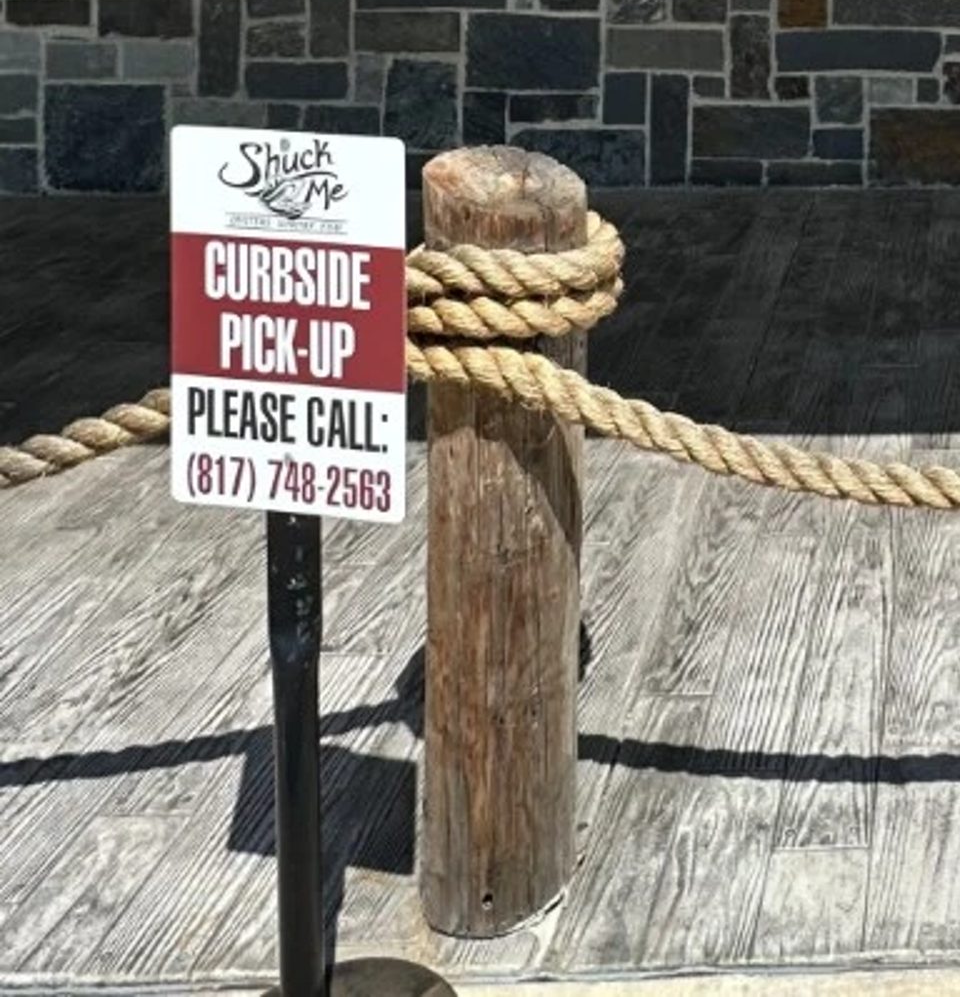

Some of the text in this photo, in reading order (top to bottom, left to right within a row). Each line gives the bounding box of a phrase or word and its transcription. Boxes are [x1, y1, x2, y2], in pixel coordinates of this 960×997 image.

[217, 138, 334, 188] Shuck
[305, 179, 348, 210] Me
[204, 240, 371, 311] CURBSIDE
[220, 311, 356, 379] PICK-UP
[187, 386, 389, 454] PLEASE CALL:
[187, 452, 391, 513] (817) 748-2563
